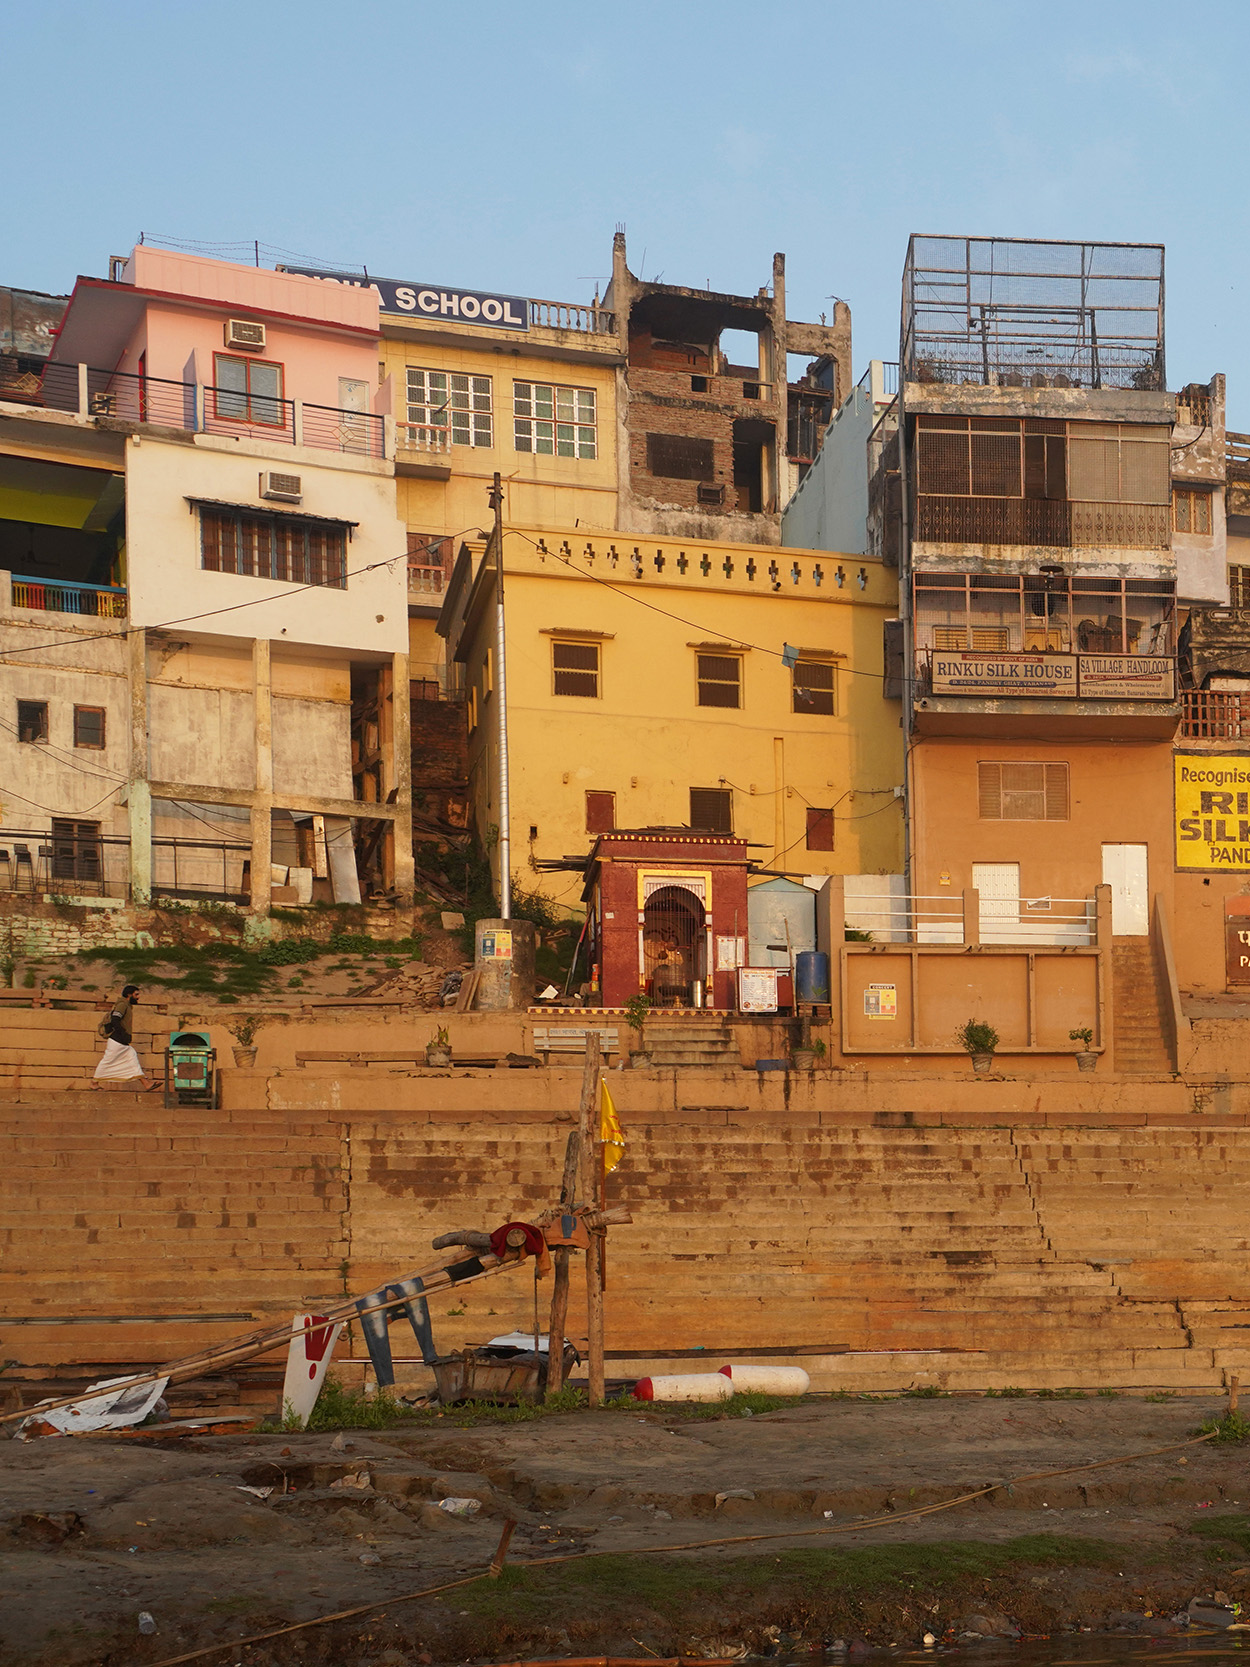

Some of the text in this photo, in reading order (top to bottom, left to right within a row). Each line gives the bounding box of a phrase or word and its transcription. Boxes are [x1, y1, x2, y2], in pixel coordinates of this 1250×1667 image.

[395, 287, 522, 325] SCHOOL
[937, 662, 1072, 679] RINKU SILK HOUSE
[1080, 659, 1169, 674] SA VILLAGE HANDLOOM
